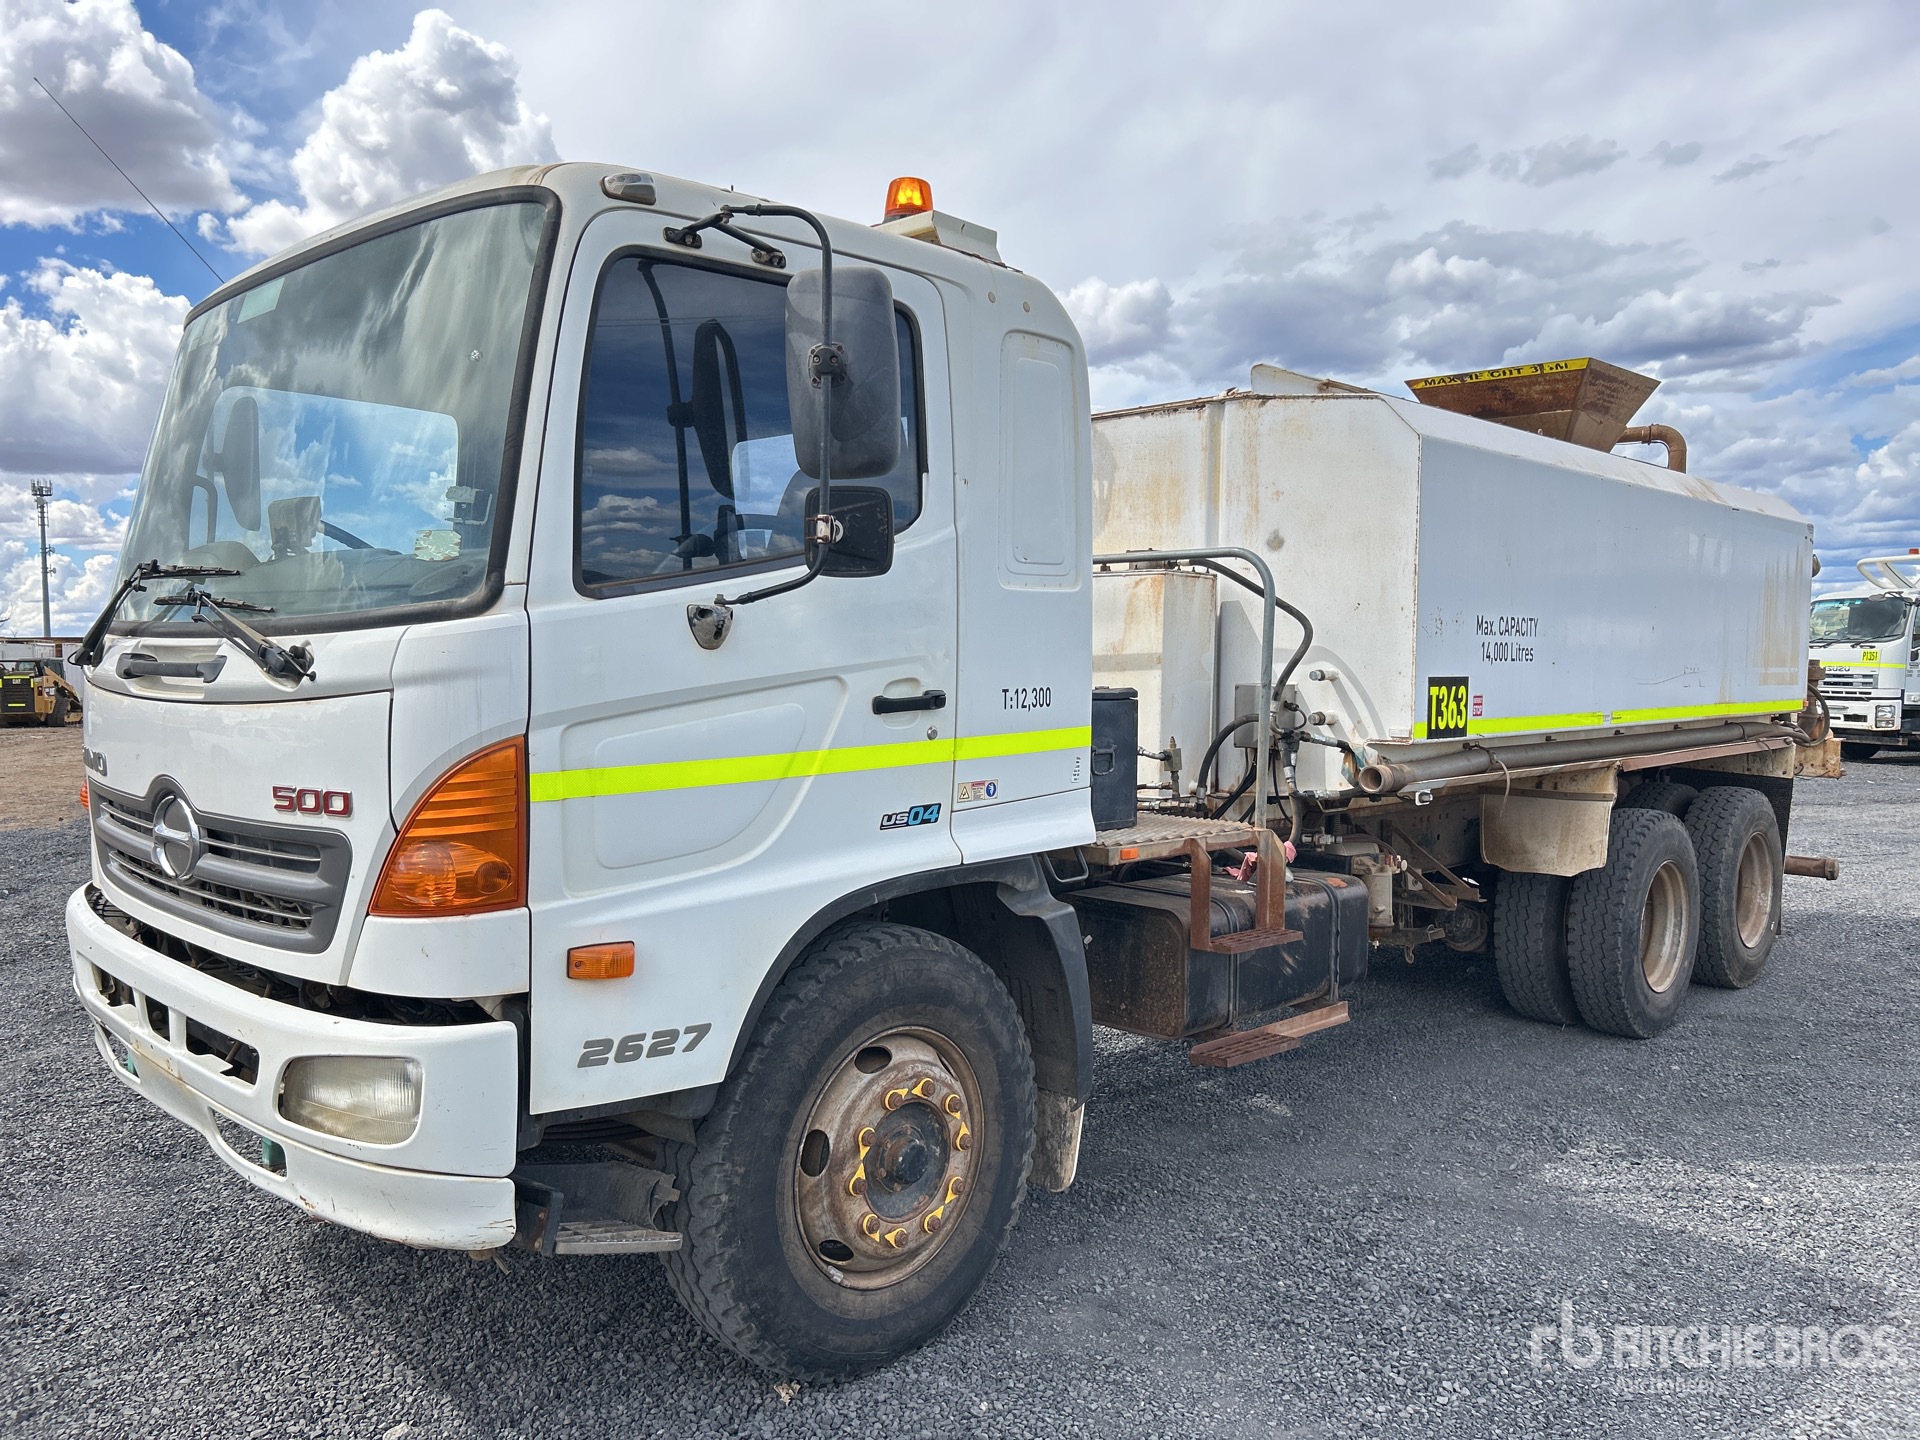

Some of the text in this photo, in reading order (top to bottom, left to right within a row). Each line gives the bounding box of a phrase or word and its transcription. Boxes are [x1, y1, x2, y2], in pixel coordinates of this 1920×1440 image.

[1424, 376, 1457, 387] MAX
[1476, 614, 1539, 638] Max. CAPACITY
[1481, 641, 1534, 666] 14,000 Litres
[1001, 686, 1052, 712] T:12,300
[1429, 685, 1467, 730] T363
[272, 784, 353, 817] 500
[577, 1022, 713, 1069] 2627
